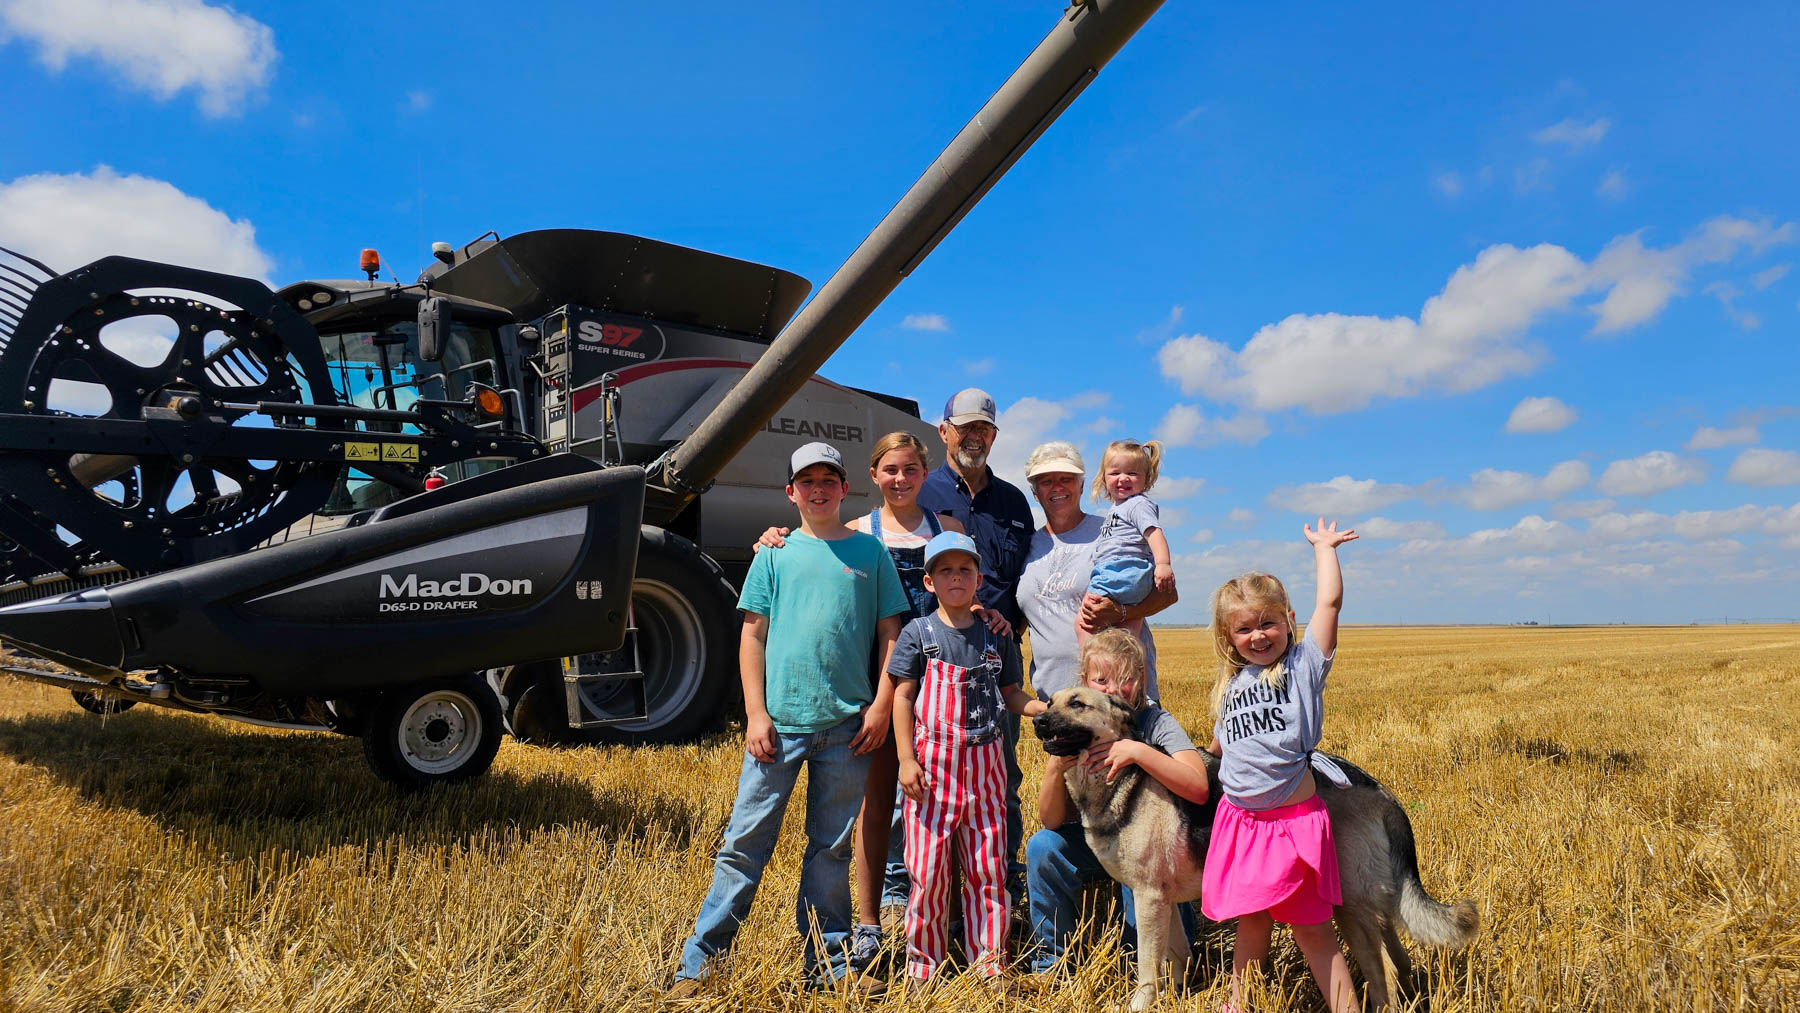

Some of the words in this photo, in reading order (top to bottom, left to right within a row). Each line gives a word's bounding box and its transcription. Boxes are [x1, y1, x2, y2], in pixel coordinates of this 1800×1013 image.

[578, 320, 643, 347] S97
[578, 343, 610, 354] SUPER
[612, 348, 646, 359] SERIES
[760, 417, 863, 442] LEANER
[379, 573, 533, 598] MacDon
[1034, 572, 1078, 600] Local
[379, 602, 421, 612] D65-D
[422, 600, 478, 611] DRAPER
[1225, 707, 1287, 745] FARMS
